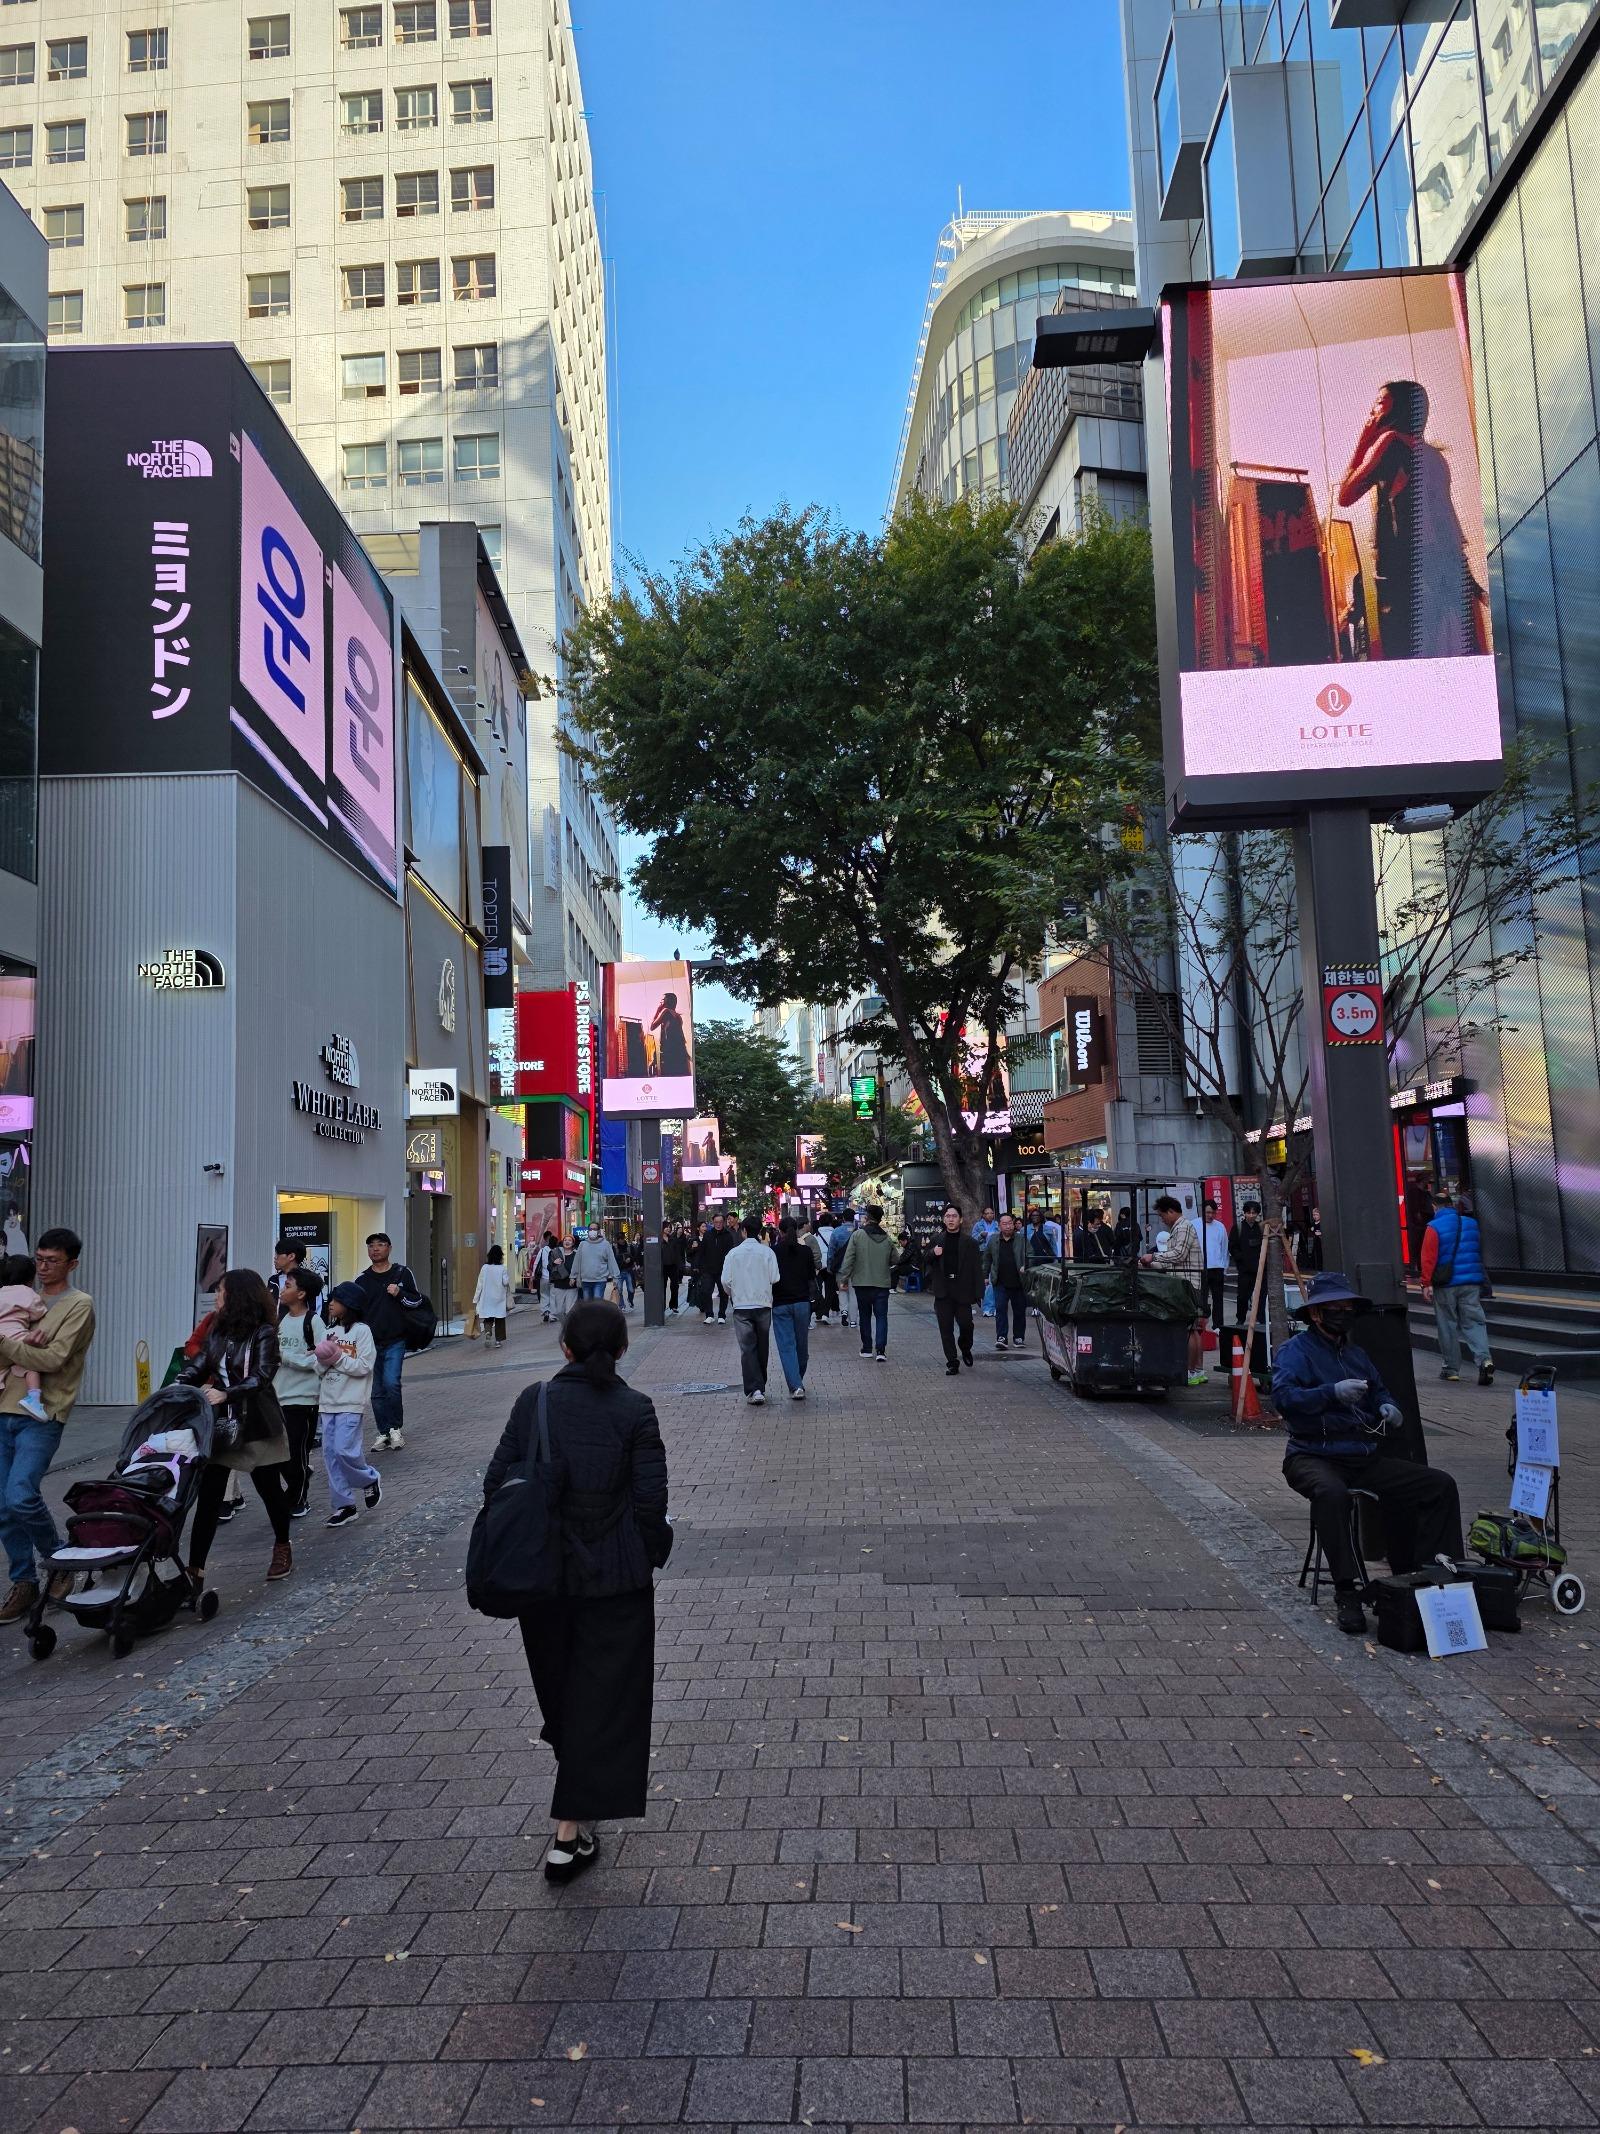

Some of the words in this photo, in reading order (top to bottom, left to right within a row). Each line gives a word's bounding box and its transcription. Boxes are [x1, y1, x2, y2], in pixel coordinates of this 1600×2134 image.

[152, 440, 183, 453] THE
[127, 452, 183, 466] NORTH
[143, 464, 183, 478] FACE
[151, 521, 190, 720] ミョンドン
[1300, 723, 1373, 740] LOTTE
[163, 949, 194, 962] THE
[138, 962, 194, 977] NORTH
[1324, 969, 1380, 986] 제한높이
[154, 975, 194, 988] FACE
[1336, 1006, 1374, 1020] 3.5m
[577, 1005, 591, 1044] DRUG
[335, 1034, 350, 1053] THE
[1075, 1009, 1093, 1071] Wilson
[324, 1046, 350, 1070] NORTH
[331, 1064, 350, 1085] FACE
[577, 1044, 591, 1095] STORE
[411, 1088, 440, 1096] NORTH
[424, 1081, 440, 1089] THE
[295, 1081, 343, 1121] WHITE
[346, 1096, 383, 1130] LABEL
[318, 1122, 365, 1145] COLLECTION
[1017, 1145, 1036, 1155] too
